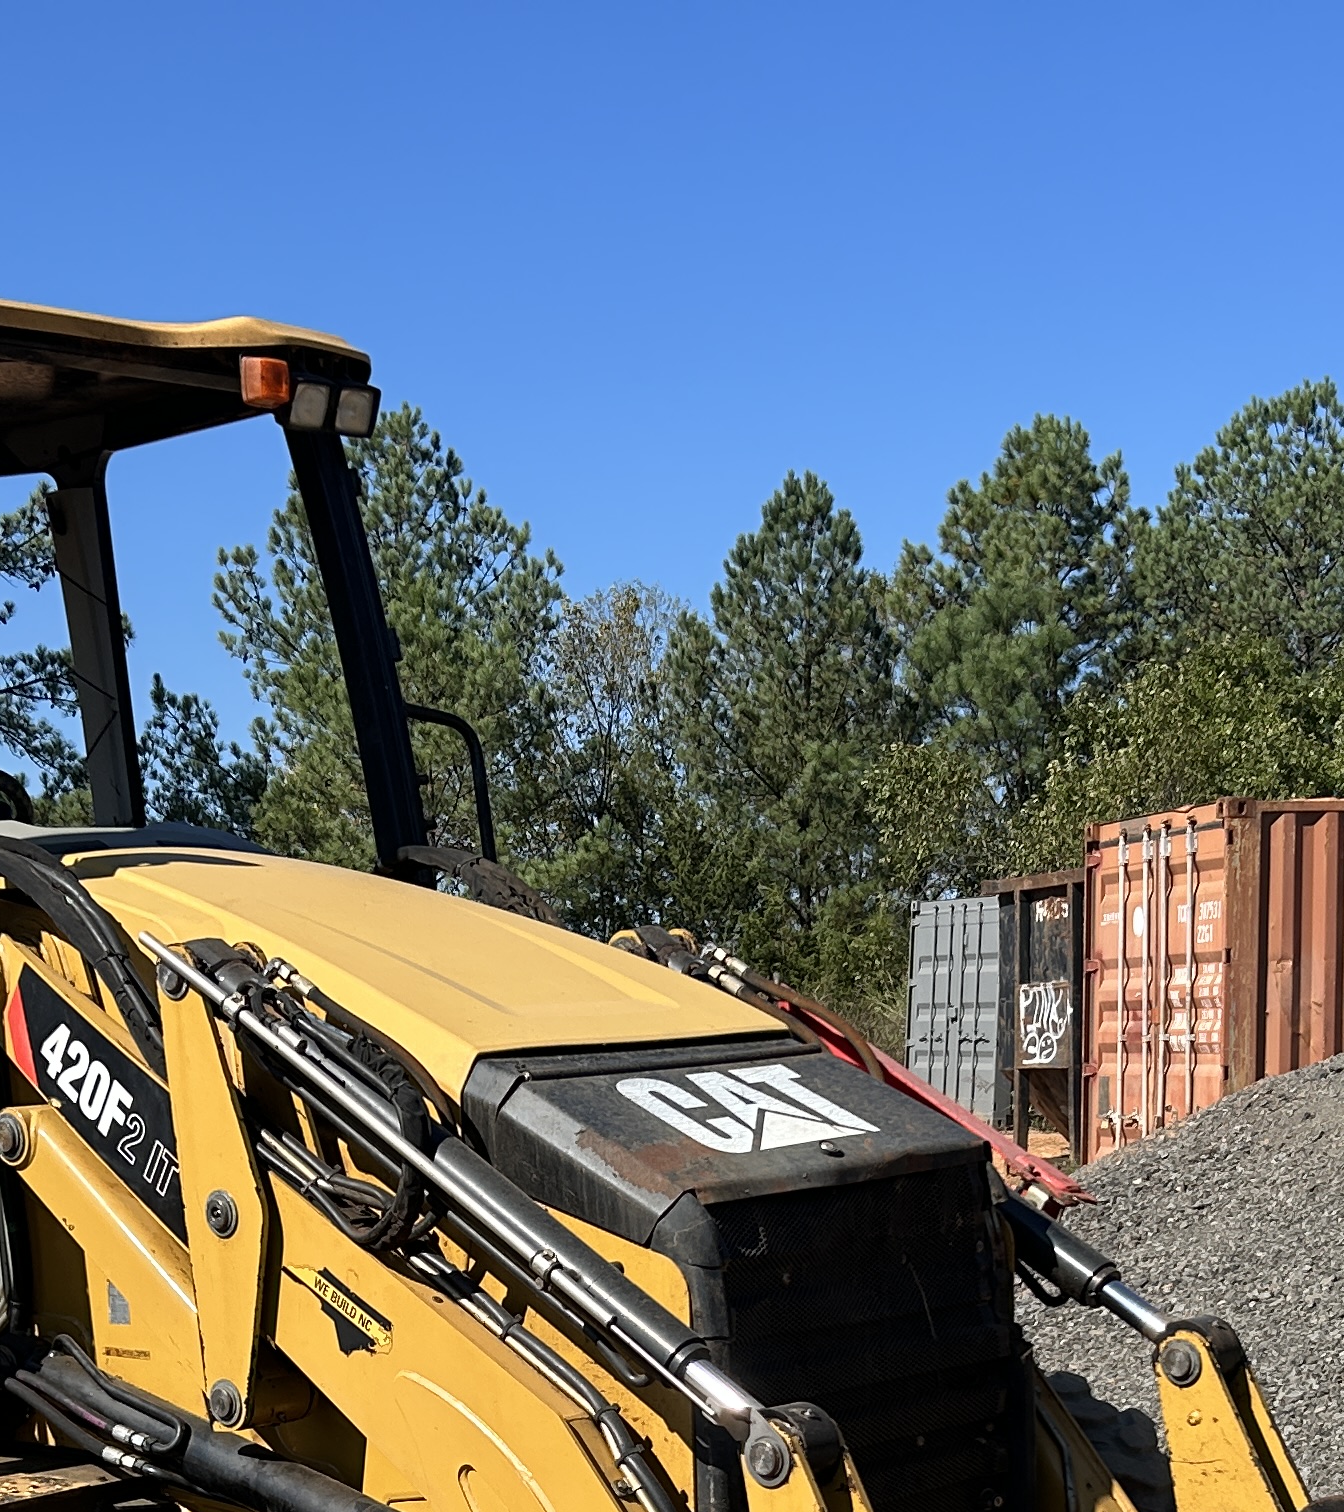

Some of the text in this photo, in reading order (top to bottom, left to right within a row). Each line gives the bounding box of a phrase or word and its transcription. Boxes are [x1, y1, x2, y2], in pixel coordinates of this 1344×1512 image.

[40, 1022, 180, 1197] 420F2 IT
[615, 1063, 882, 1154] CAT
[314, 1276, 373, 1333] WE BUILD NC
